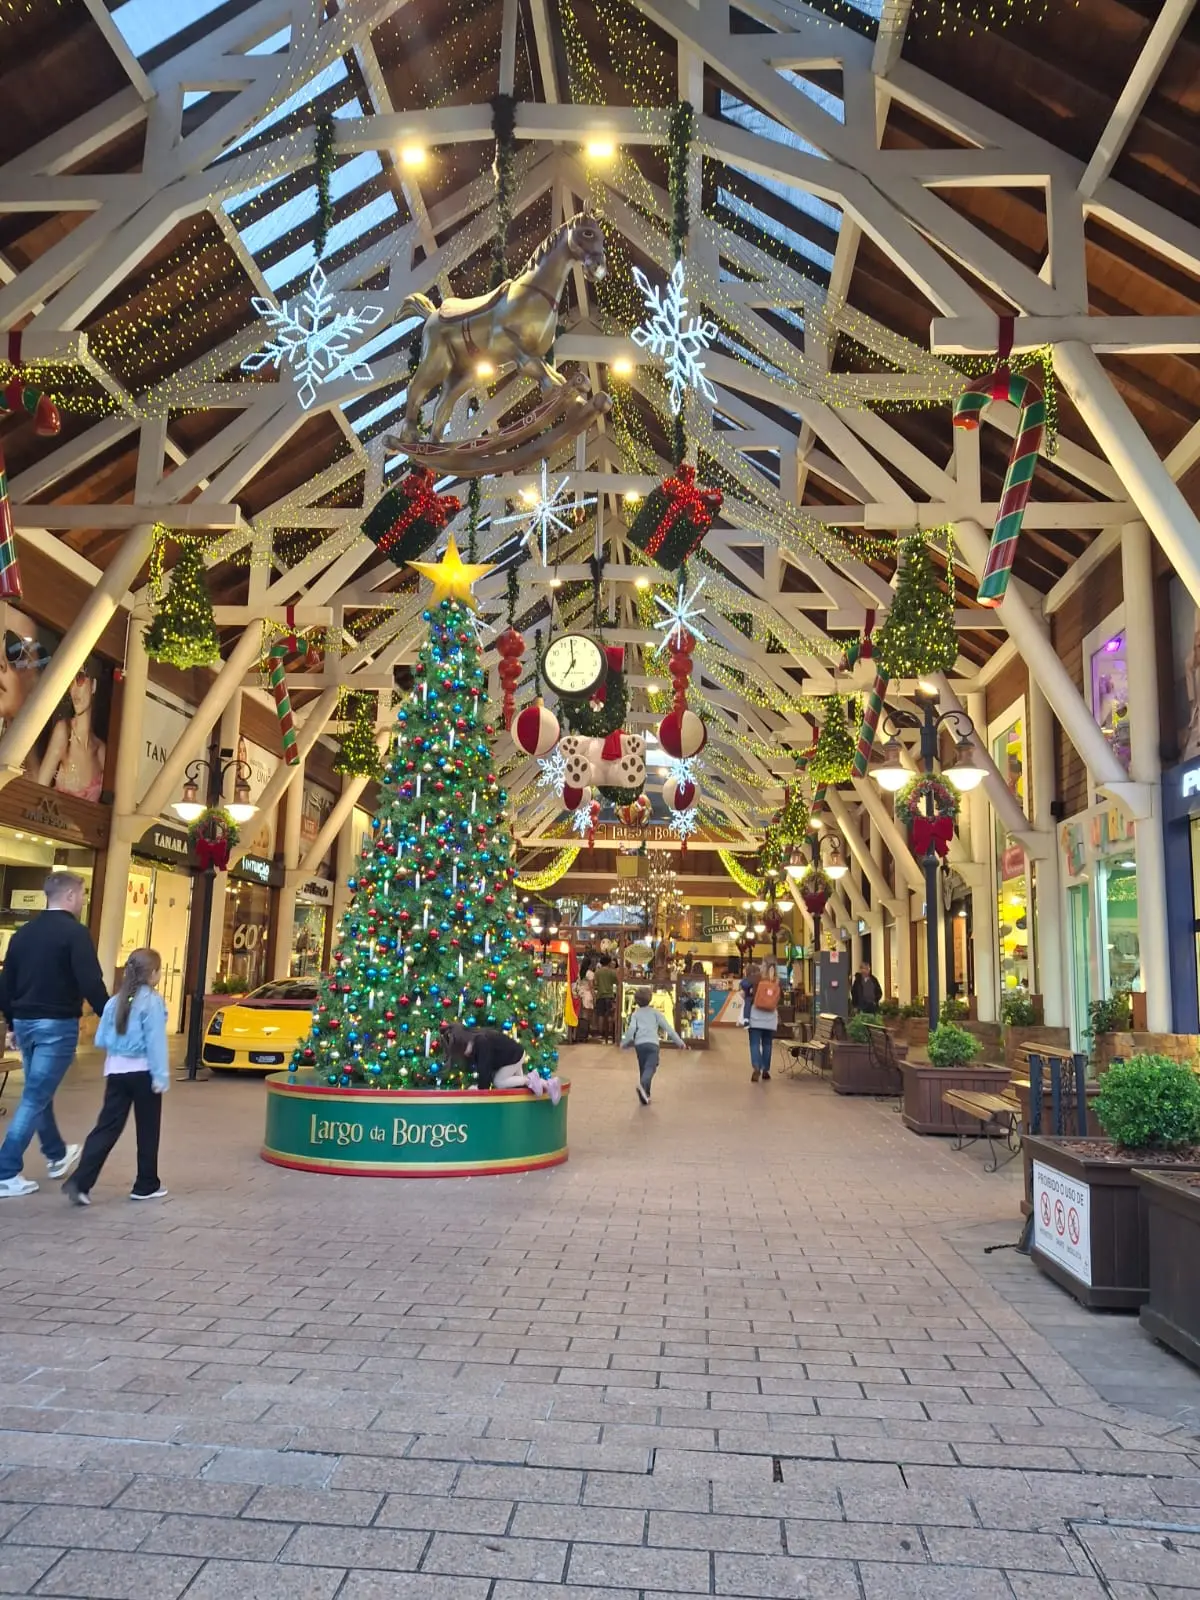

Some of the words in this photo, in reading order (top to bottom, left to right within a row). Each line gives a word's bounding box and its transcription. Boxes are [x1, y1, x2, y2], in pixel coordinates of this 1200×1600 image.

[154, 832, 189, 855] TANARA
[654, 825, 692, 841] Borgs
[310, 1113, 364, 1146] Largo
[369, 1125, 386, 1142] da
[391, 1117, 468, 1148] Borges
[1037, 1171, 1060, 1193] PROIBIDO
[1059, 1183, 1065, 1196] O
[1064, 1185, 1077, 1203] USO
[1076, 1191, 1085, 1207] DE
